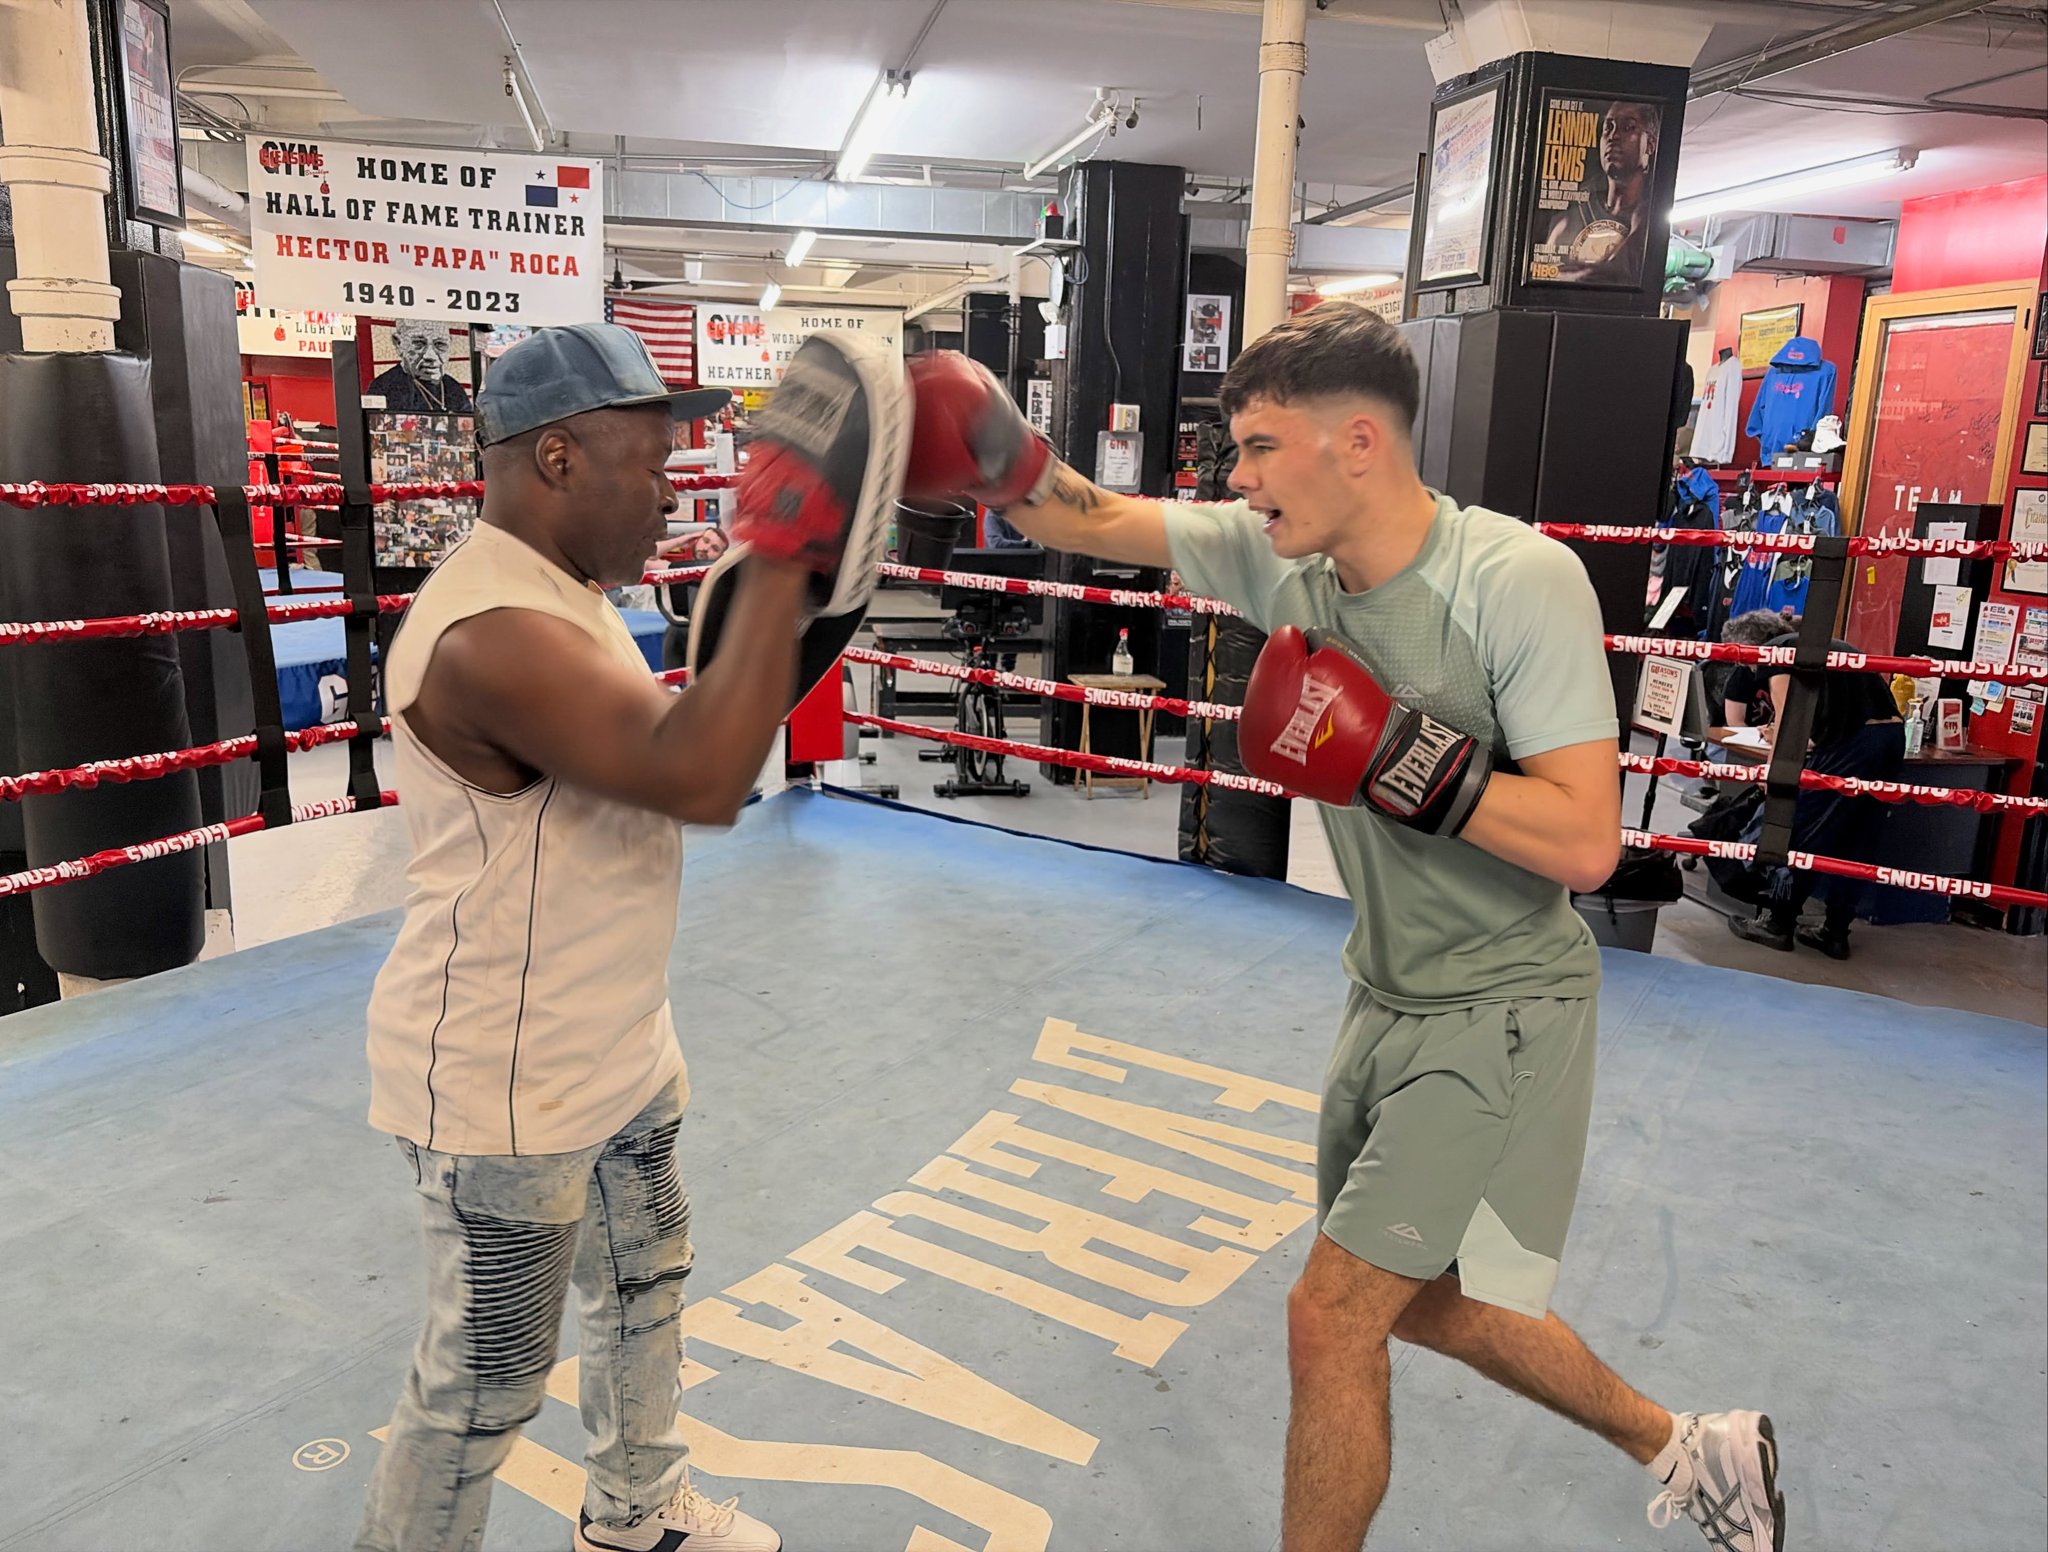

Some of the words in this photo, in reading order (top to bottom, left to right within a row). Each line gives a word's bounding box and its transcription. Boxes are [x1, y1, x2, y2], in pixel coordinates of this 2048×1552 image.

[1545, 109, 1599, 148] LENNOX
[357, 157, 447, 185] HOME
[460, 166, 496, 189] OF
[1542, 144, 1587, 182] LEWIS
[266, 191, 336, 219] HALL
[346, 198, 376, 221] OF
[387, 202, 459, 228] FAME
[468, 208, 585, 237] TRAINER
[276, 234, 390, 264] HECTOR
[401, 243, 499, 271] "PAPA"
[510, 252, 579, 277] ROCA
[1532, 262, 1559, 278] HBO
[343, 281, 414, 307] 1940
[447, 289, 520, 313] 2023
[296, 322, 334, 335] LIGHT
[801, 317, 842, 329] HOME
[847, 318, 865, 329] OF
[708, 366, 772, 380] HEATHER
[1379, 713, 1467, 806] EVERLAST
